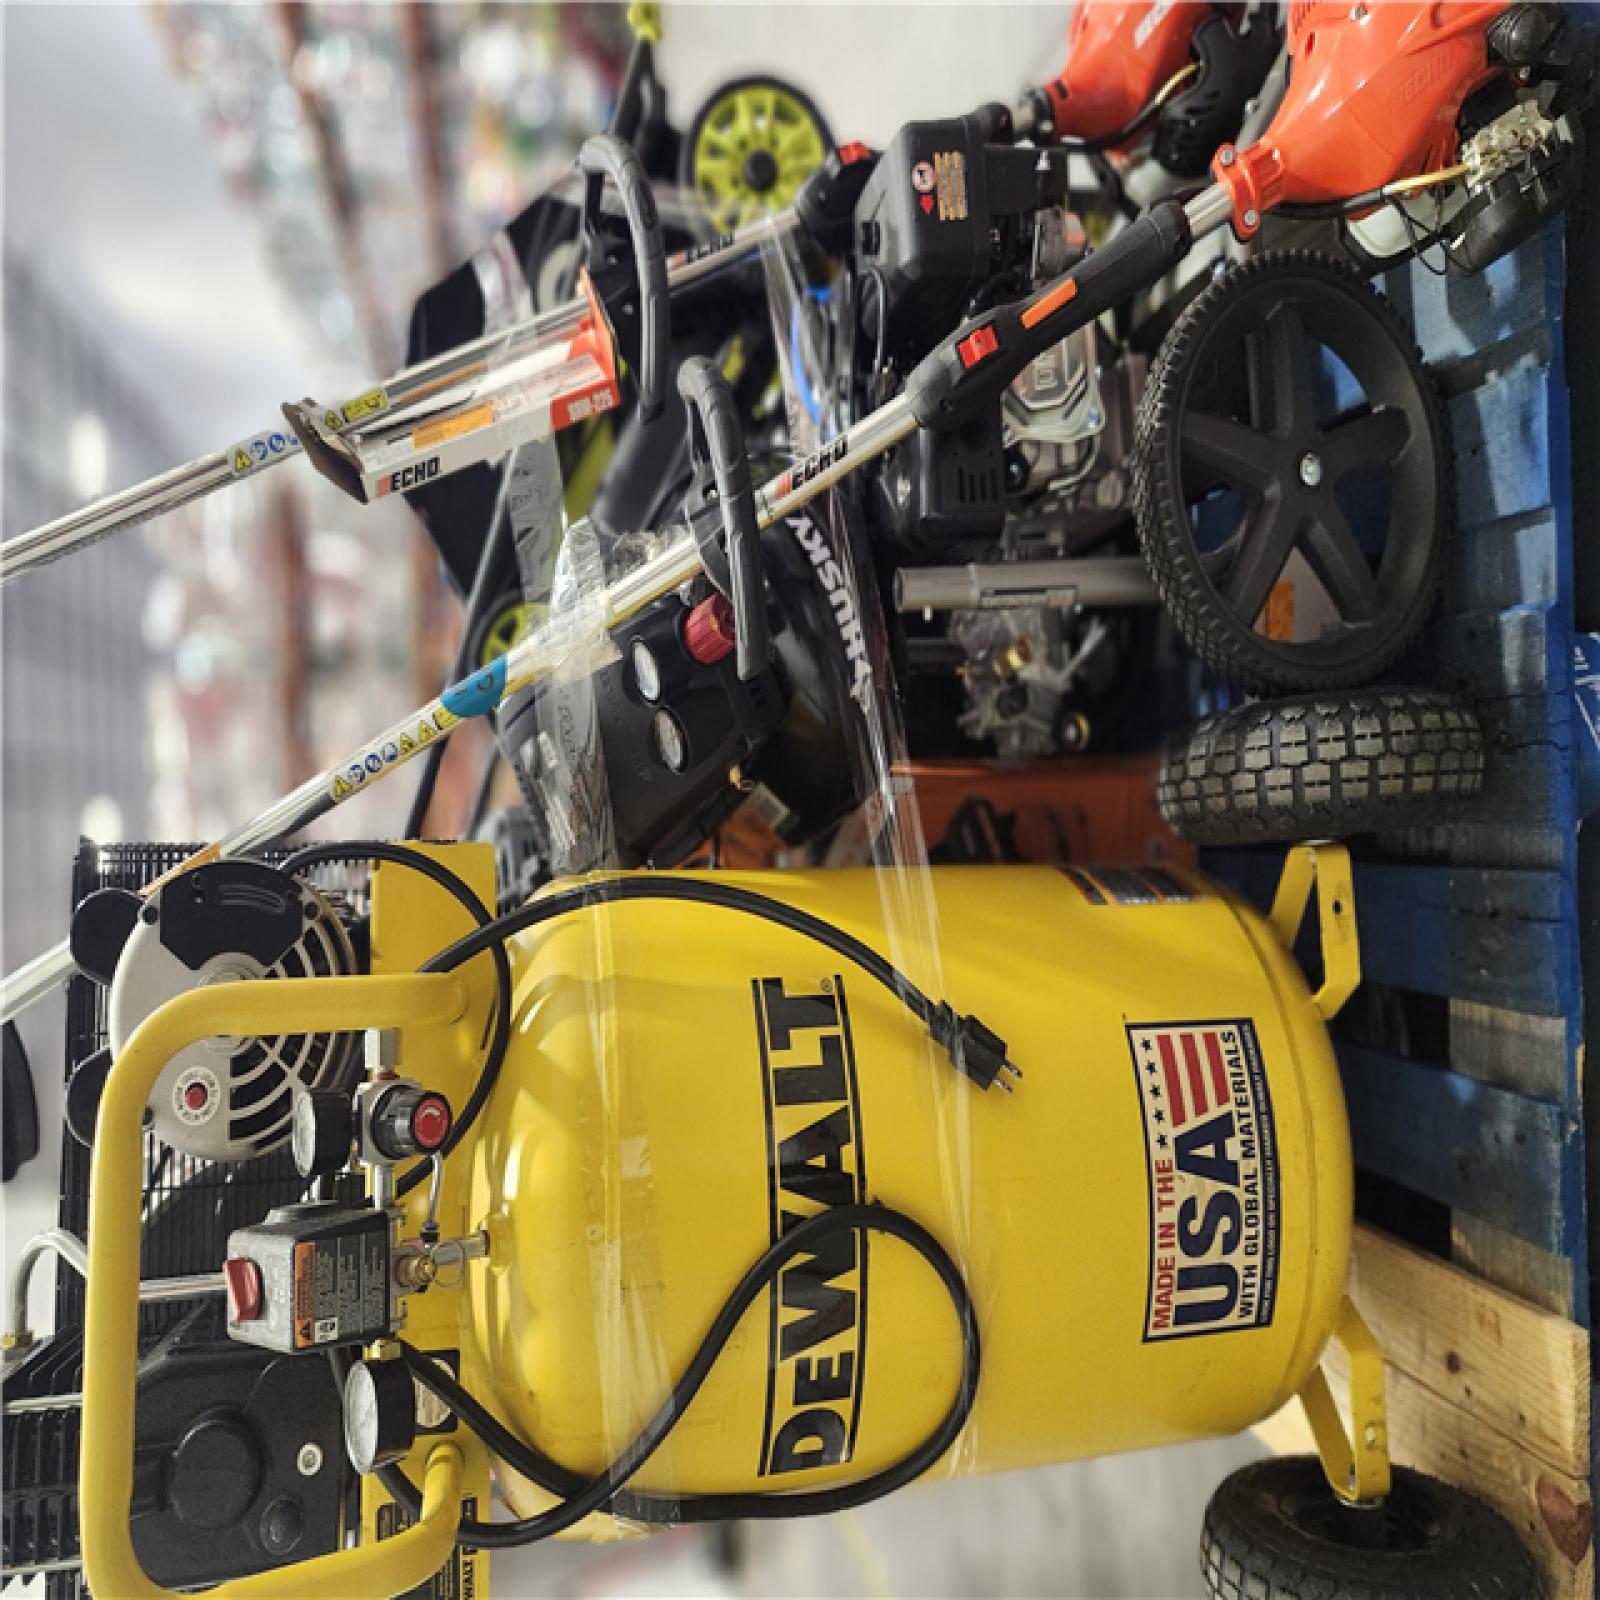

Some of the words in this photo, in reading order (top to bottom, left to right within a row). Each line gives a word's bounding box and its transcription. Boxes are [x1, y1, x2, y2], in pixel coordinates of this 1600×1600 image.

[391, 456, 441, 492] ECHO
[791, 432, 848, 491] ECHO
[785, 517, 866, 661] HUSKY
[1219, 1029, 1258, 1158] MATERIALS
[1155, 1159, 1176, 1212] THE
[1173, 1110, 1242, 1327] USA
[1244, 1167, 1261, 1257] GLOBAL
[762, 978, 857, 1474] DEWALT
[1159, 1221, 1176, 1249] IN
[1152, 1255, 1176, 1330] MADE
[1238, 1264, 1258, 1320] WITH
